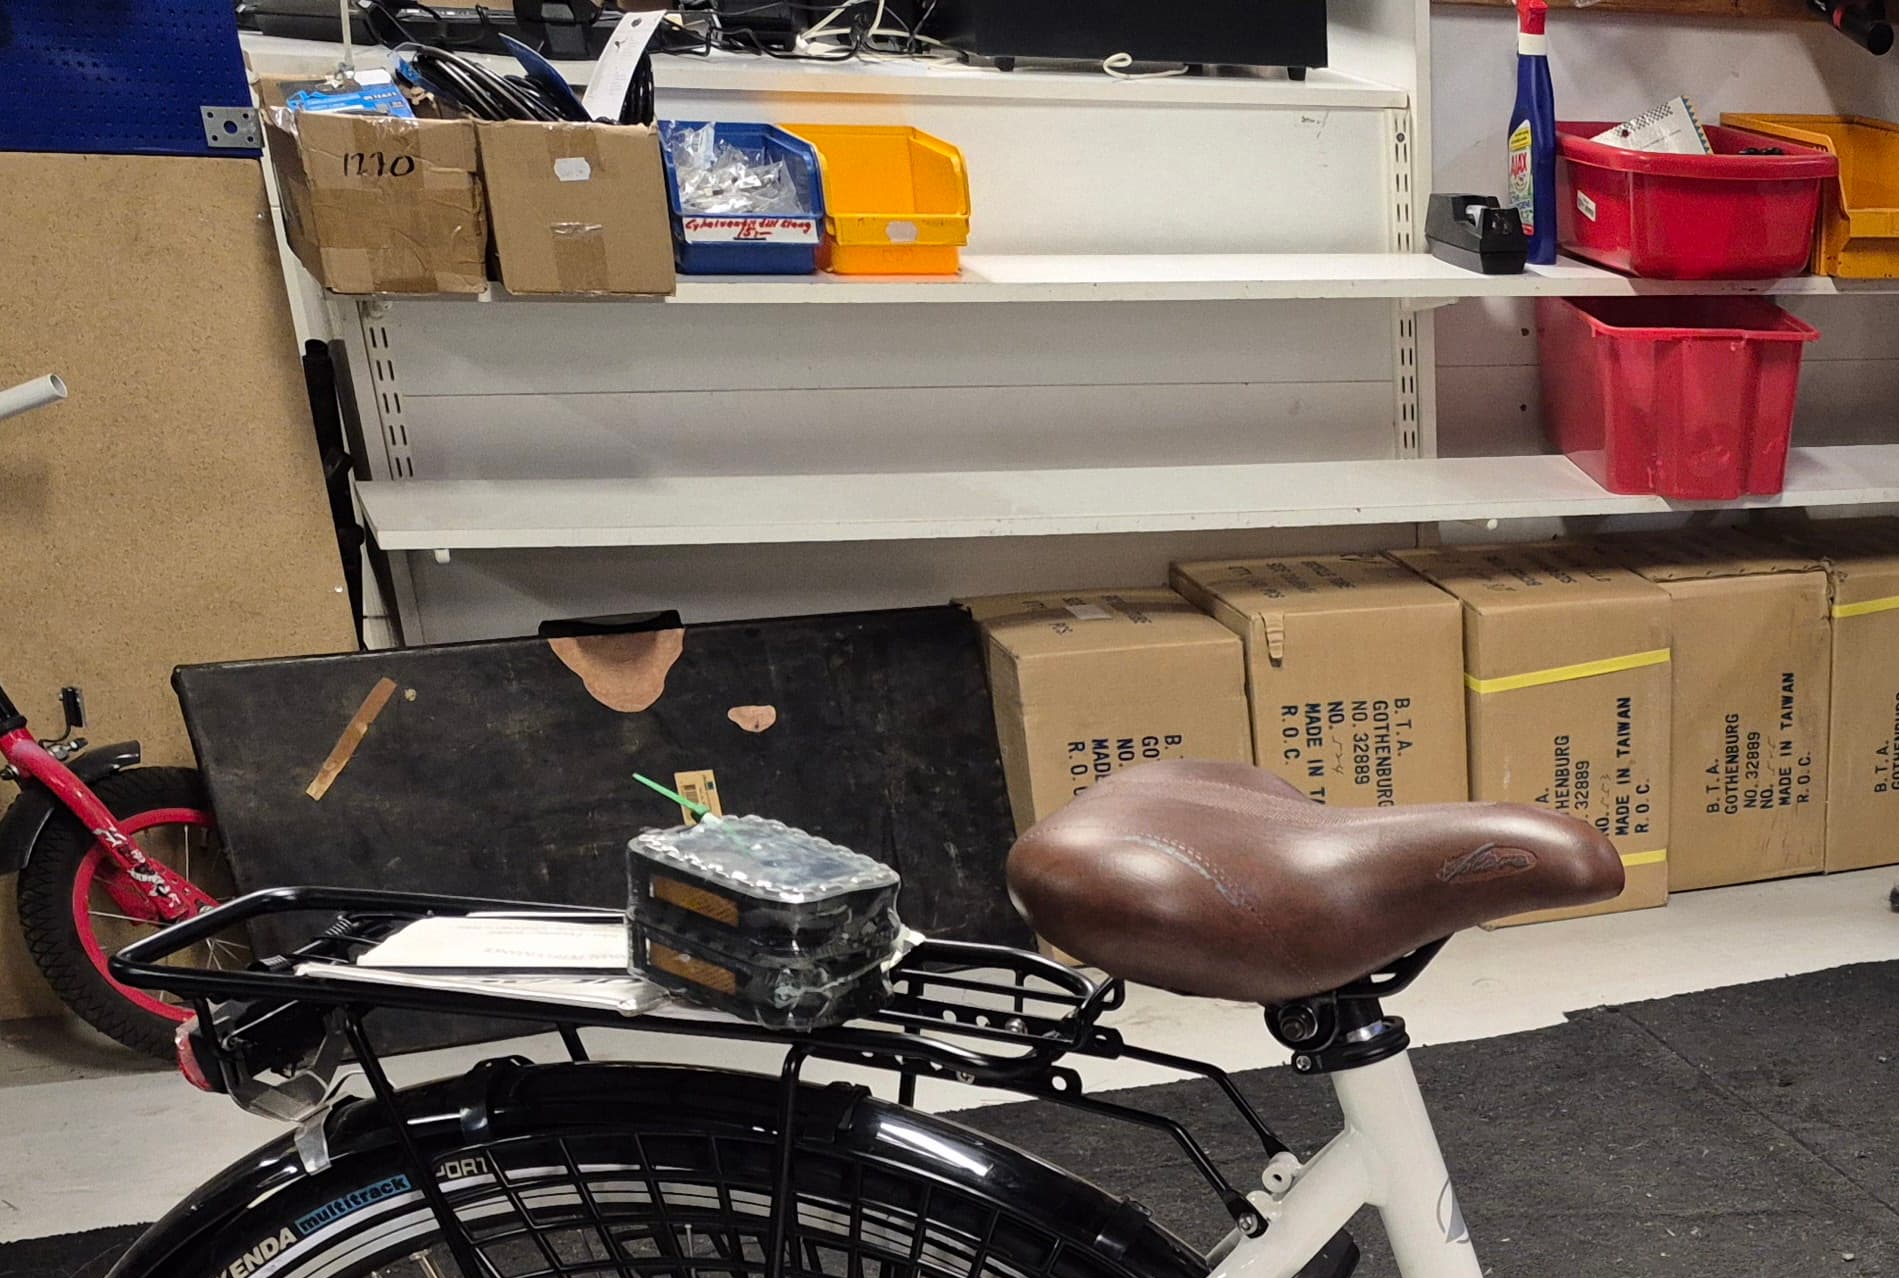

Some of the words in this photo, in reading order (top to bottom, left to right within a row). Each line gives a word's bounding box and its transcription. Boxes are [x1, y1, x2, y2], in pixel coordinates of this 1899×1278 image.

[1327, 701, 1345, 729] NO.
[1781, 672, 1795, 731] TAIWAN
[1142, 736, 1160, 760] GO
[1305, 702, 1323, 748] MADE
[1616, 697, 1632, 759] TAIWAN
[1117, 738, 1135, 767] NO.
[1308, 759, 1324, 777] IN
[1353, 733, 1370, 785] 32889
[1373, 700, 1395, 807] GOTHENBURG
[1725, 713, 1739, 815] GOTHENBURG
[1746, 731, 1760, 779] 32889
[1780, 740, 1793, 757] IN
[1554, 735, 1570, 814] HENBURG
[1575, 760, 1590, 810] 32889
[1616, 767, 1631, 785] IN
[1760, 784, 1774, 809] NO.
[1779, 767, 1793, 806] MADE
[1615, 793, 1631, 836] MADE
[299, 1175, 411, 1235] multitrack
[434, 1157, 489, 1178] ORT
